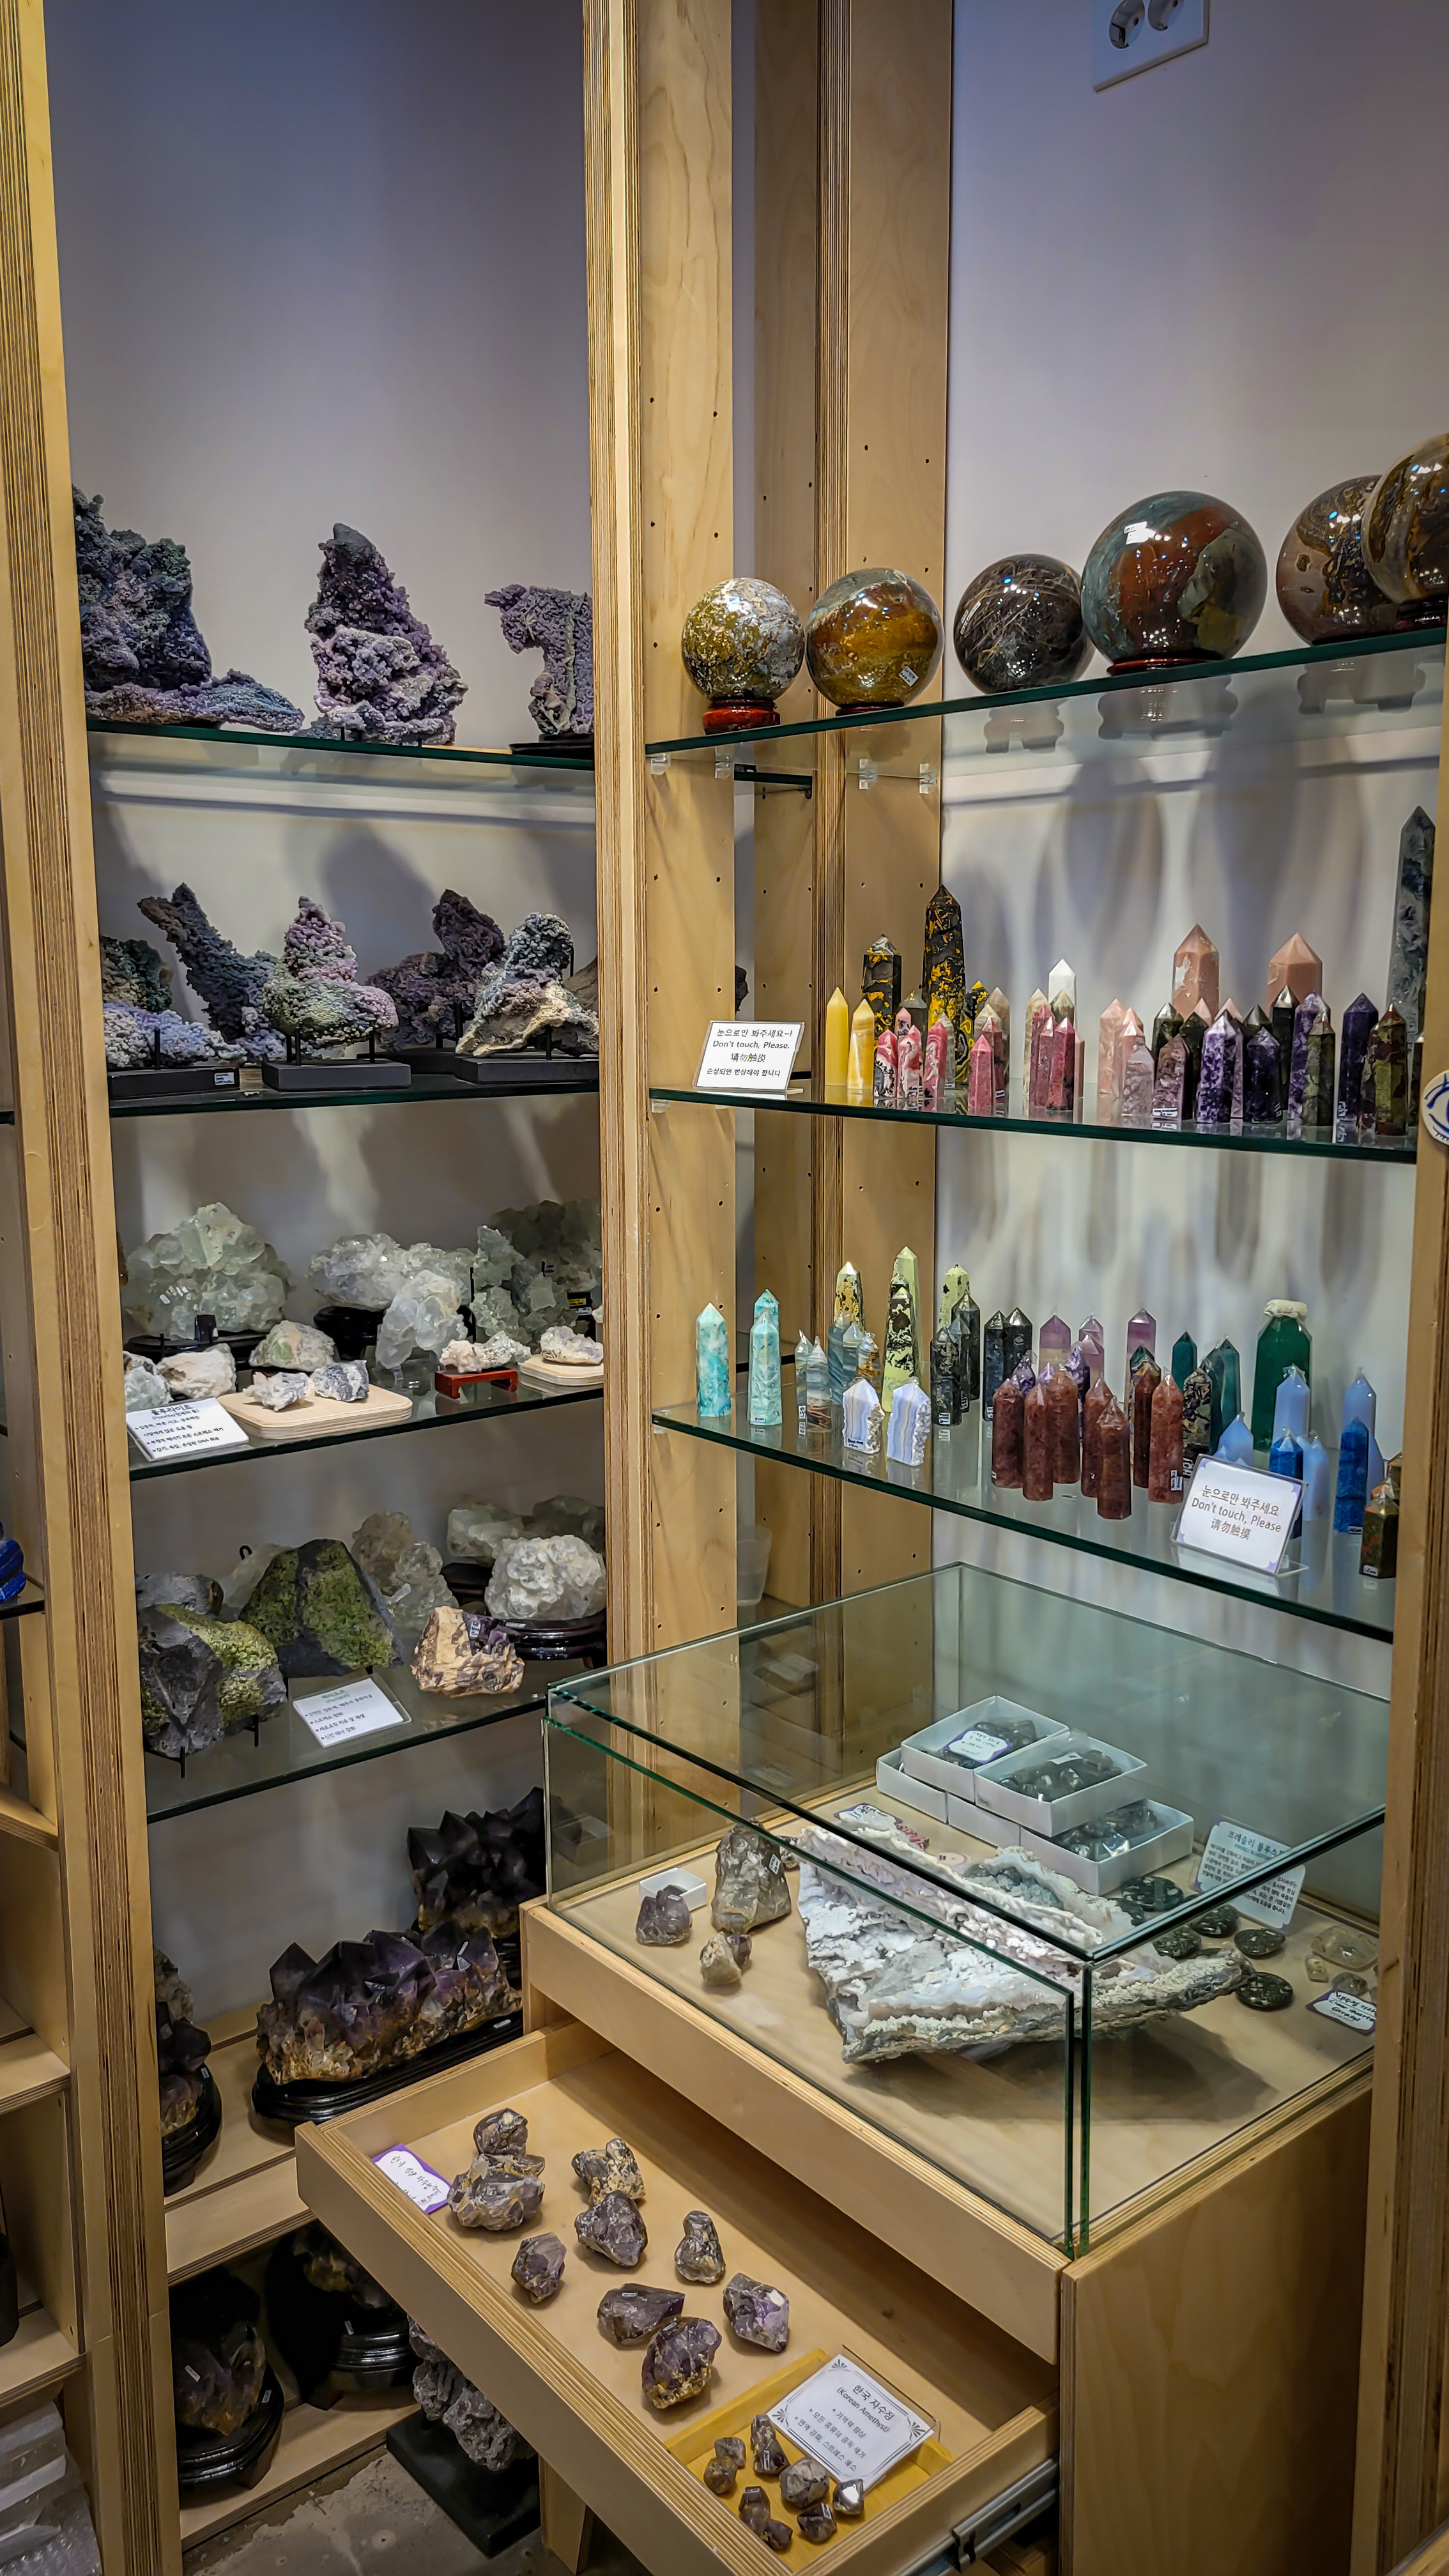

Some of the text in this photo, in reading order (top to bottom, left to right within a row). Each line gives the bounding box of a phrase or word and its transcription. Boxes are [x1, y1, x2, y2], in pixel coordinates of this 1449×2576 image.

[751, 1029, 793, 1038] 봐주세요~!
[731, 1053, 766, 1062] 请勿触摸
[1202, 1485, 1279, 1516] 눈으로만 봐주세요
[1192, 1498, 1281, 1533] Don't touch, Please
[1211, 1518, 1251, 1540] 请勿触摸
[1257, 1842, 1284, 1855] 블루스
[837, 2387, 890, 2433] (Korean Amethyst)
[852, 2385, 896, 2421] 한국 자수정
[812, 2412, 825, 2424] 모든
[836, 2411, 866, 2439] 기억력 향상
[822, 2441, 845, 2462] 스트레스
